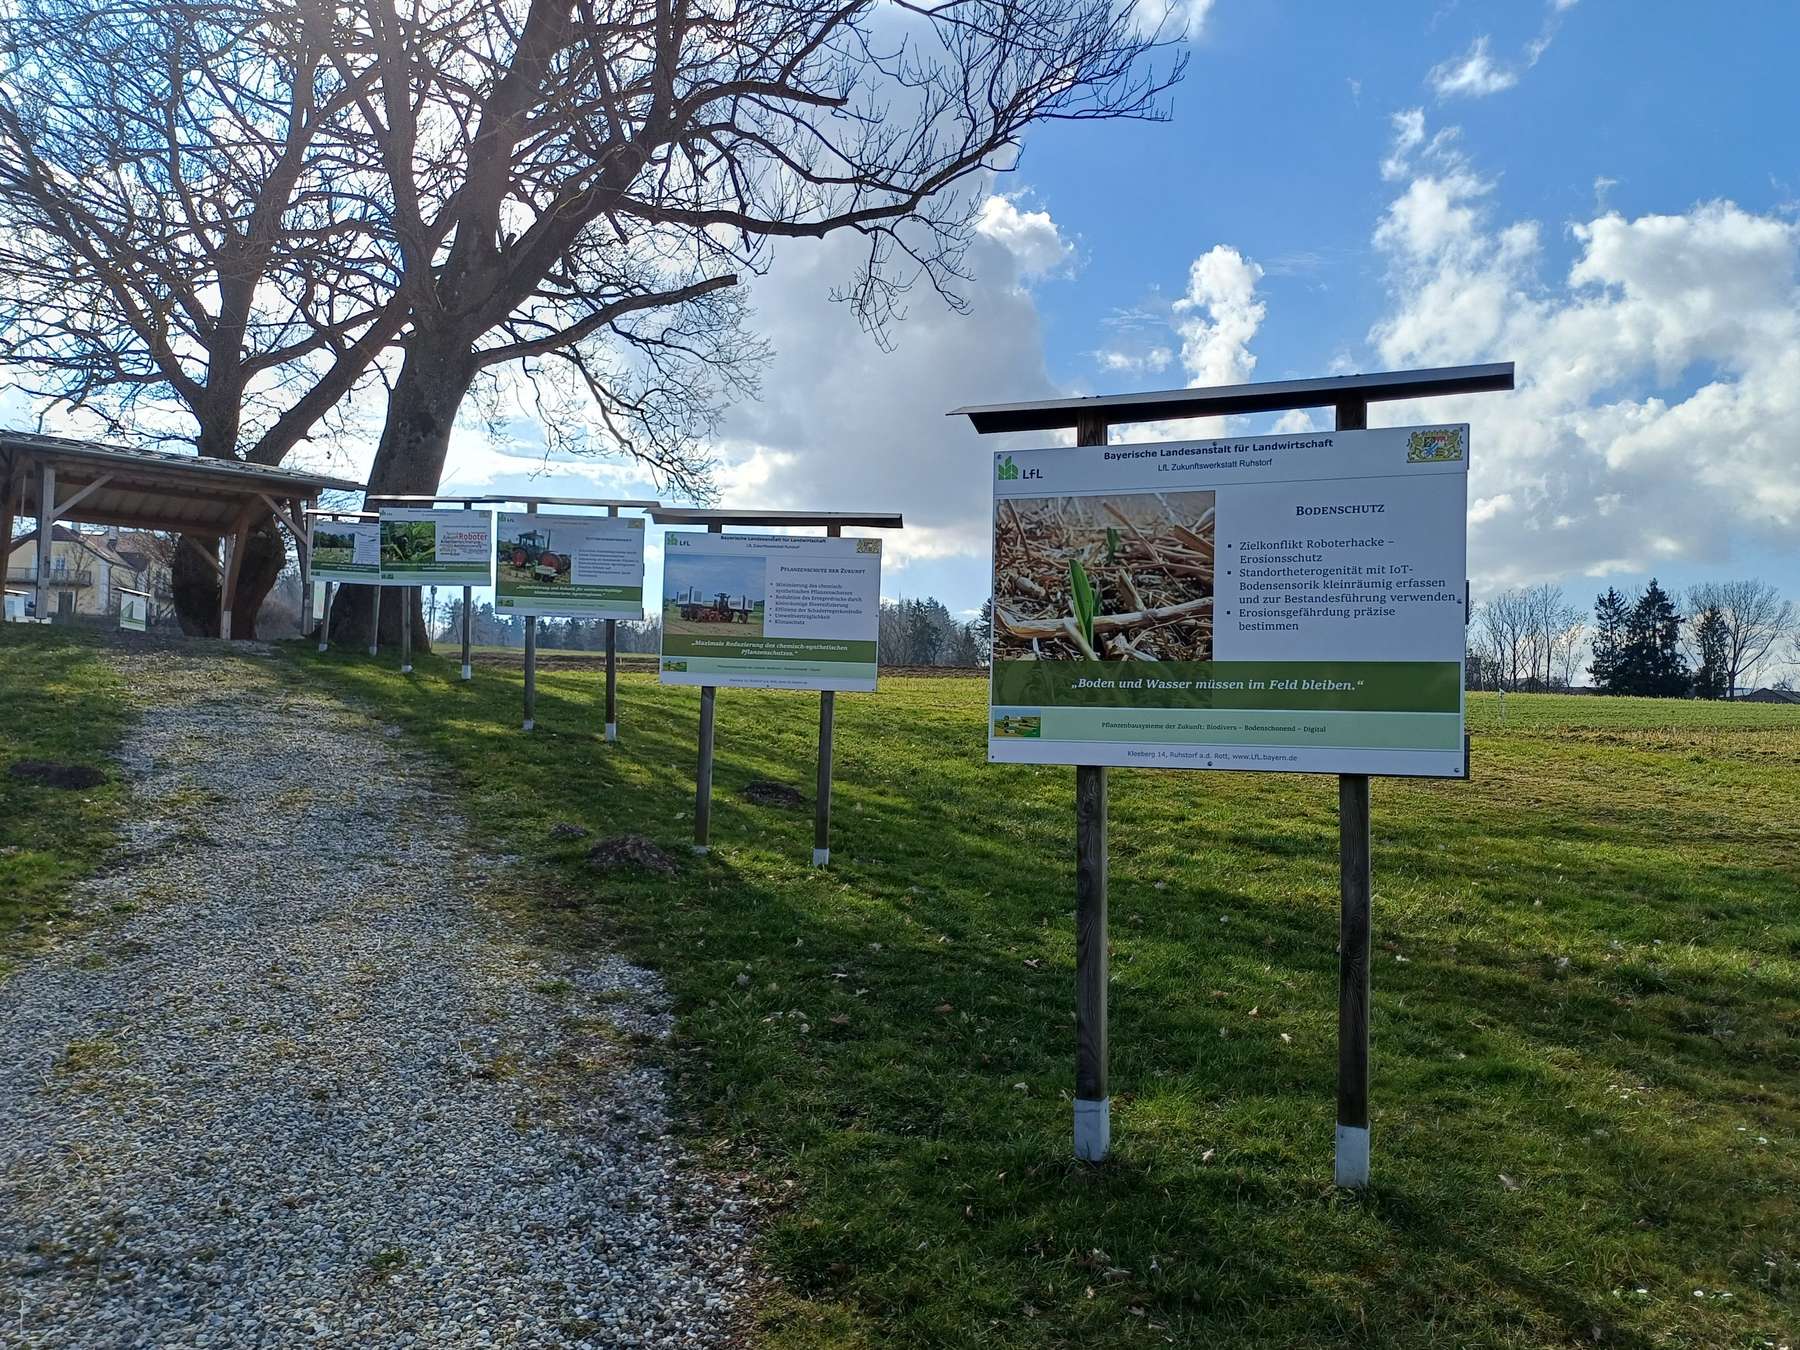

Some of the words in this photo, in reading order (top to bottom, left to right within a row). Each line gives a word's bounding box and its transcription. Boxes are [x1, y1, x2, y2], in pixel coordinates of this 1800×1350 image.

[1104, 450, 1158, 460] Bayerische
[1160, 444, 1232, 456] Landesanstalt
[1234, 443, 1250, 452] für
[1252, 438, 1334, 452] Landwirtschaft
[1171, 460, 1238, 471] Zukunftswerkstatt
[1239, 458, 1272, 468] Ruhstorf
[1022, 469, 1044, 480] LfL
[1240, 540, 1303, 550] Zielkonflikt
[1306, 538, 1384, 548] Roboterhacke
[1240, 554, 1322, 564] Erosionsschutz
[1240, 566, 1362, 578] Standortheterogenität
[1366, 566, 1386, 574] mit
[1390, 565, 1412, 574] IoT-
[1240, 581, 1320, 590] Bodensensorik
[1323, 580, 1392, 590] kleinräumig
[1396, 578, 1446, 588] erfassen
[1240, 595, 1259, 604] und
[1284, 592, 1386, 604] Bestandesführung
[1390, 592, 1456, 602] verwenden
[1239, 607, 1350, 618] Erosionsgefährdung
[1354, 608, 1396, 618] präzise
[1239, 621, 1299, 631] bestimmen
[1072, 678, 1114, 690] „Boden
[1118, 679, 1142, 689] und
[1146, 680, 1192, 690] Wasser
[1196, 679, 1244, 690] müssen
[1248, 680, 1266, 690] im
[1268, 679, 1298, 690] Feld
[1101, 722, 1164, 731] Pflanzenbausysteme
[1303, 726, 1326, 734] Digital
[1158, 751, 1168, 759] 14,
